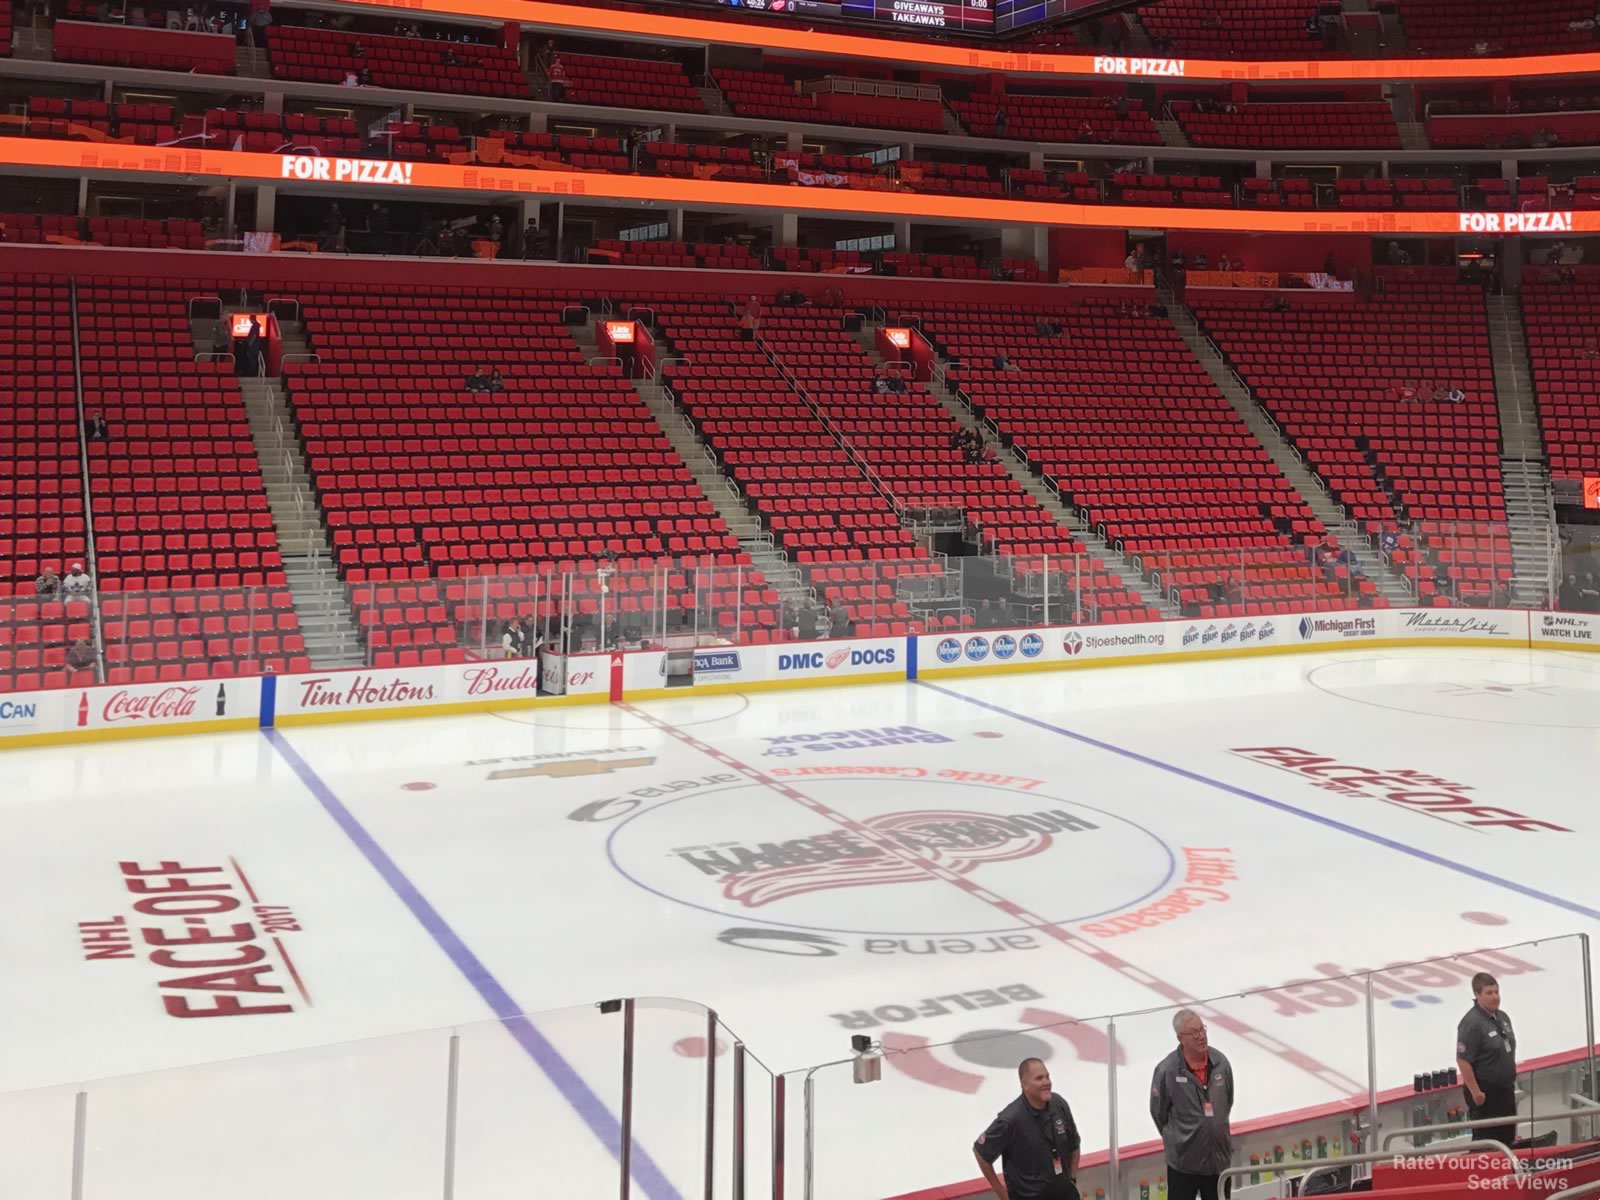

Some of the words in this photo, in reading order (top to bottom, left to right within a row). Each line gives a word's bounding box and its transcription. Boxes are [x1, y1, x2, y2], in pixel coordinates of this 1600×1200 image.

[894, 1, 944, 15] GIVEAWAYS
[892, 12, 945, 26] TAKEAWAYS
[1094, 57, 1127, 75] FOR
[1130, 58, 1184, 76] PIZZA!
[282, 155, 330, 180] FOR
[335, 158, 413, 185] PIZZA!
[1459, 212, 1500, 232] FOR
[1503, 211, 1572, 232] PIZZA!
[1314, 618, 1353, 632] Michigan
[1354, 617, 1375, 629] First
[1541, 628, 1571, 638] WATCH
[1573, 630, 1592, 639] LIVE
[1086, 632, 1164, 649] Stjoeshealth.org
[1182, 631, 1199, 646] Blue
[1202, 630, 1219, 645] Blue
[1221, 628, 1238, 643] Blue
[1240, 626, 1257, 642] Blue
[1258, 625, 1275, 640] Blue
[711, 656, 734, 666] Bank
[778, 652, 823, 671] DMC
[851, 648, 895, 666] DOCS
[300, 678, 342, 707] Tim
[348, 676, 435, 703] Hortons
[103, 686, 202, 721] Coca-Cola
[760, 725, 934, 745] Wilcox
[802, 732, 955, 752] Burns
[769, 765, 929, 778] Caesars
[1383, 768, 1478, 793] NHL
[628, 773, 742, 798] arena
[1229, 746, 1577, 832] FACE-OFF
[252, 905, 302, 934] 2017
[77, 915, 136, 961] NHL
[118, 860, 295, 1019] FACE-OFF
[863, 934, 1041, 955] arena
[828, 983, 1047, 1031] BELFOR
